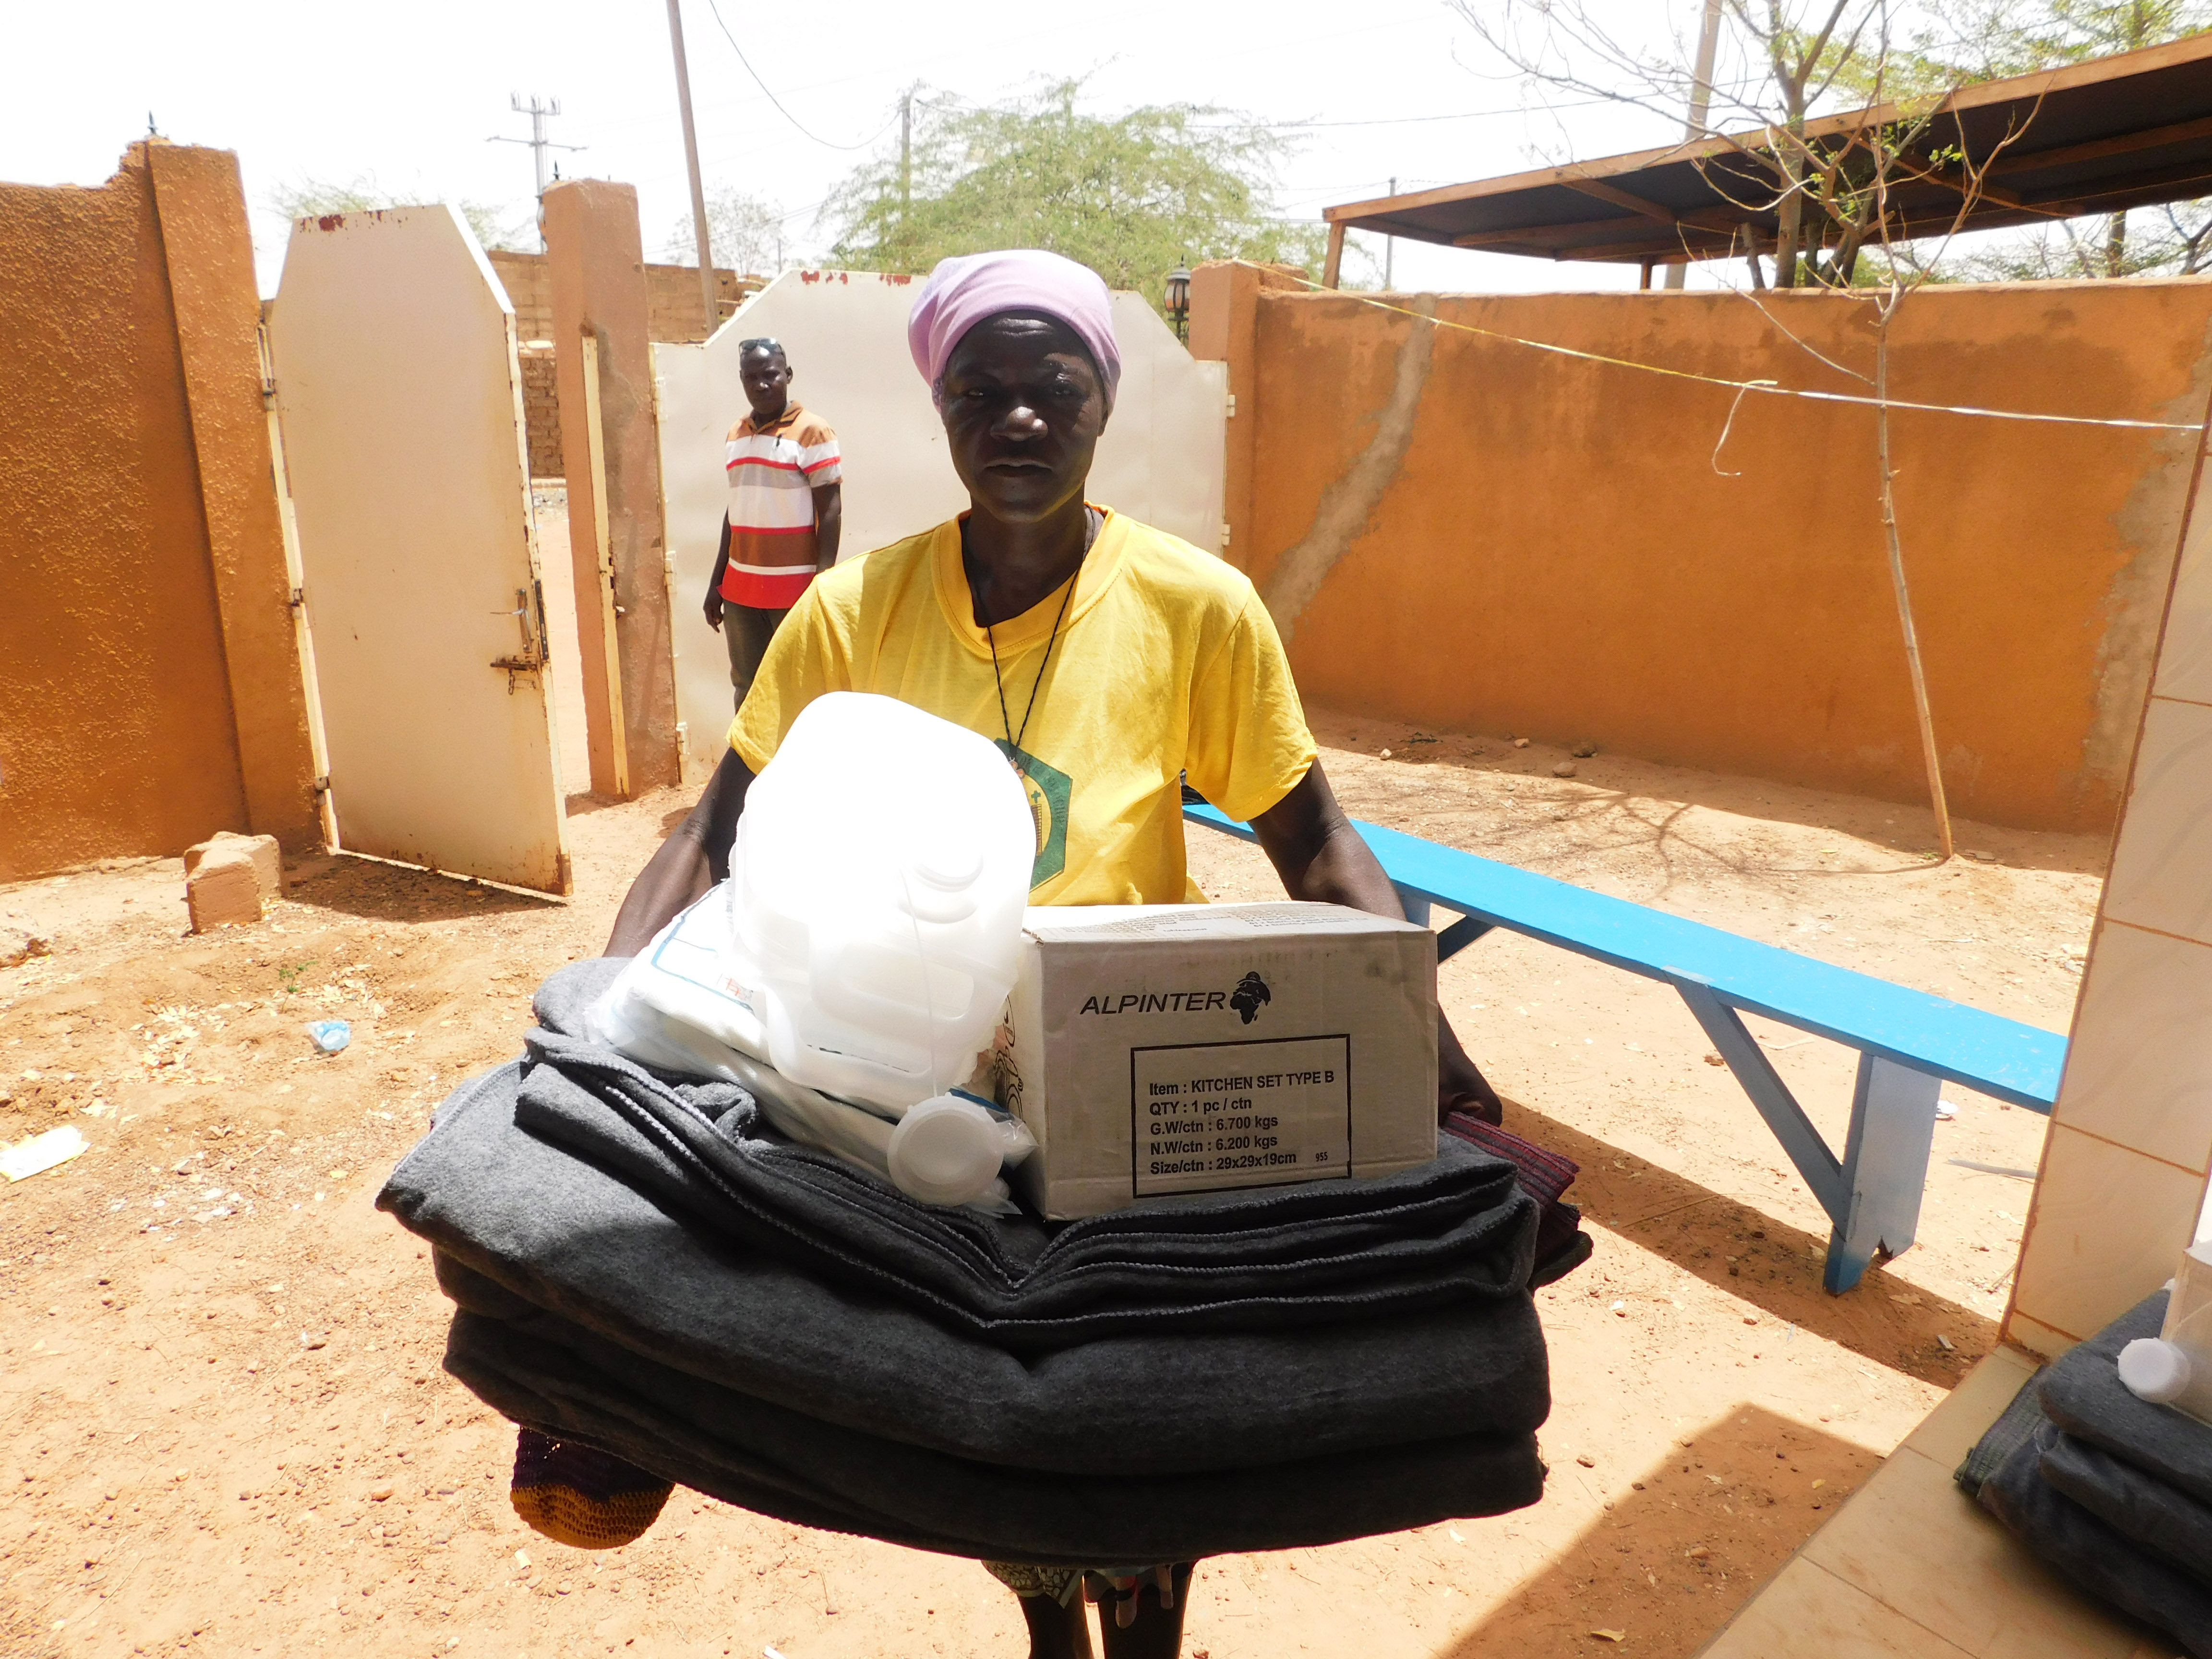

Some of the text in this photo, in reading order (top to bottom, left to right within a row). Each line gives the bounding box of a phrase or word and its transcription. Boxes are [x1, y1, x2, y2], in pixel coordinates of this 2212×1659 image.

[1080, 992, 1226, 1015] ALPINTER
[1149, 1083, 1179, 1096] Item
[1191, 1076, 1253, 1093] KITCHEN
[1257, 1074, 1283, 1088] SET
[1286, 1071, 1321, 1086] TYPE
[1324, 1070, 1334, 1083] B
[1149, 1101, 1180, 1116] QTY
[1191, 1100, 1198, 1113] 1
[1203, 1101, 1219, 1115] pc
[1223, 1098, 1228, 1111] /
[1231, 1097, 1252, 1110] ctn
[1150, 1120, 1203, 1135] G.W/ctn
[1216, 1116, 1251, 1131] 6.700
[1255, 1115, 1278, 1130] kgs
[1150, 1140, 1203, 1155] N.W/ctn
[1215, 1136, 1250, 1151] 6.200
[1254, 1135, 1278, 1150] kgs
[1150, 1159, 1204, 1175] Size/ctn
[1216, 1154, 1297, 1170] 29x29x19cm
[1315, 1151, 1328, 1162] 955
